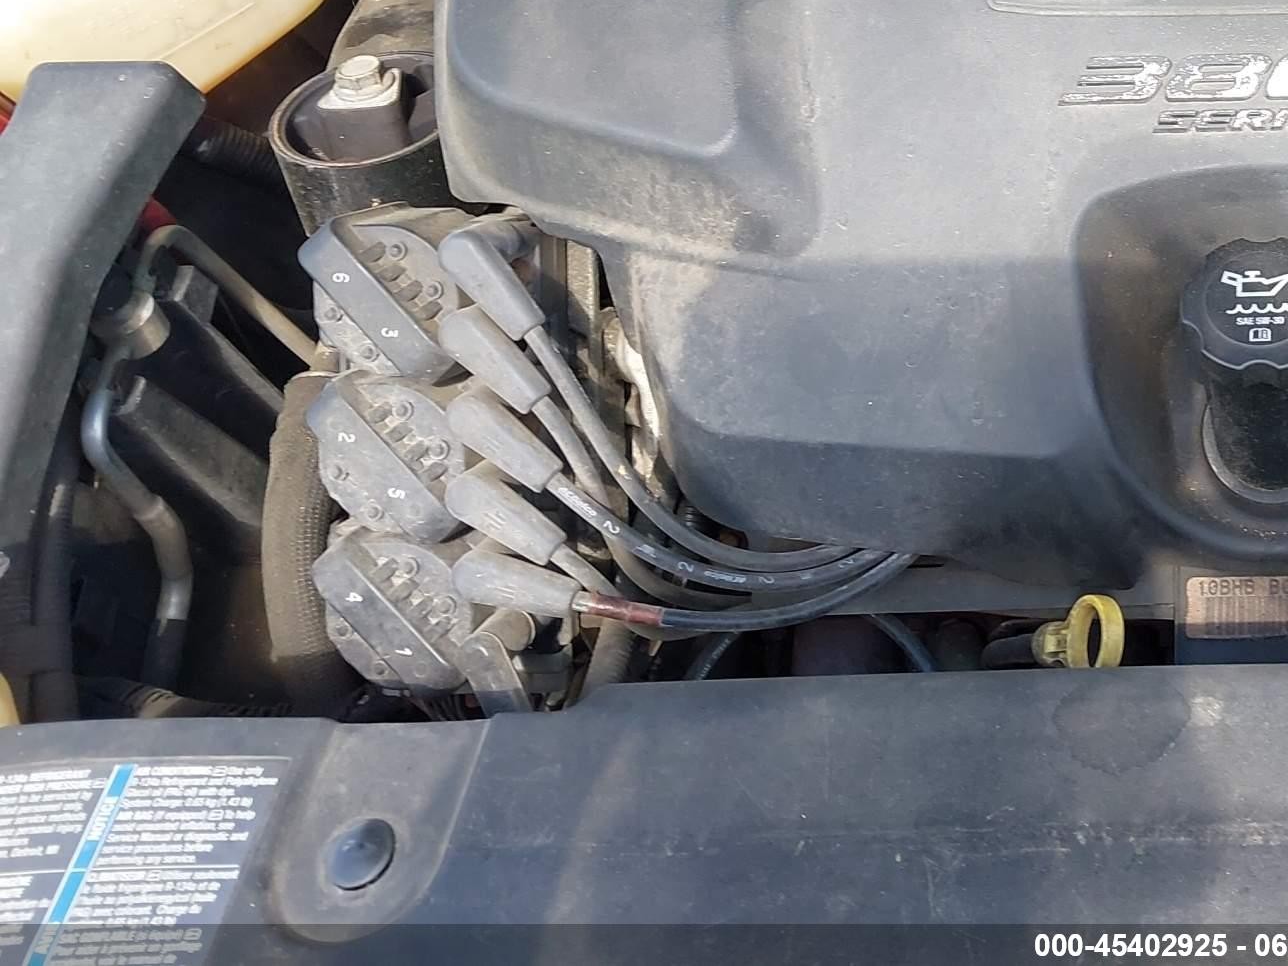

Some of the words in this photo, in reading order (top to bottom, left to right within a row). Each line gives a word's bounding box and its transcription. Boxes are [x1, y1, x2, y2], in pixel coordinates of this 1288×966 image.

[332, 272, 350, 284] 6
[381, 326, 399, 339] 3
[338, 431, 355, 444] 2
[387, 487, 405, 501] 5
[345, 592, 362, 603] 4
